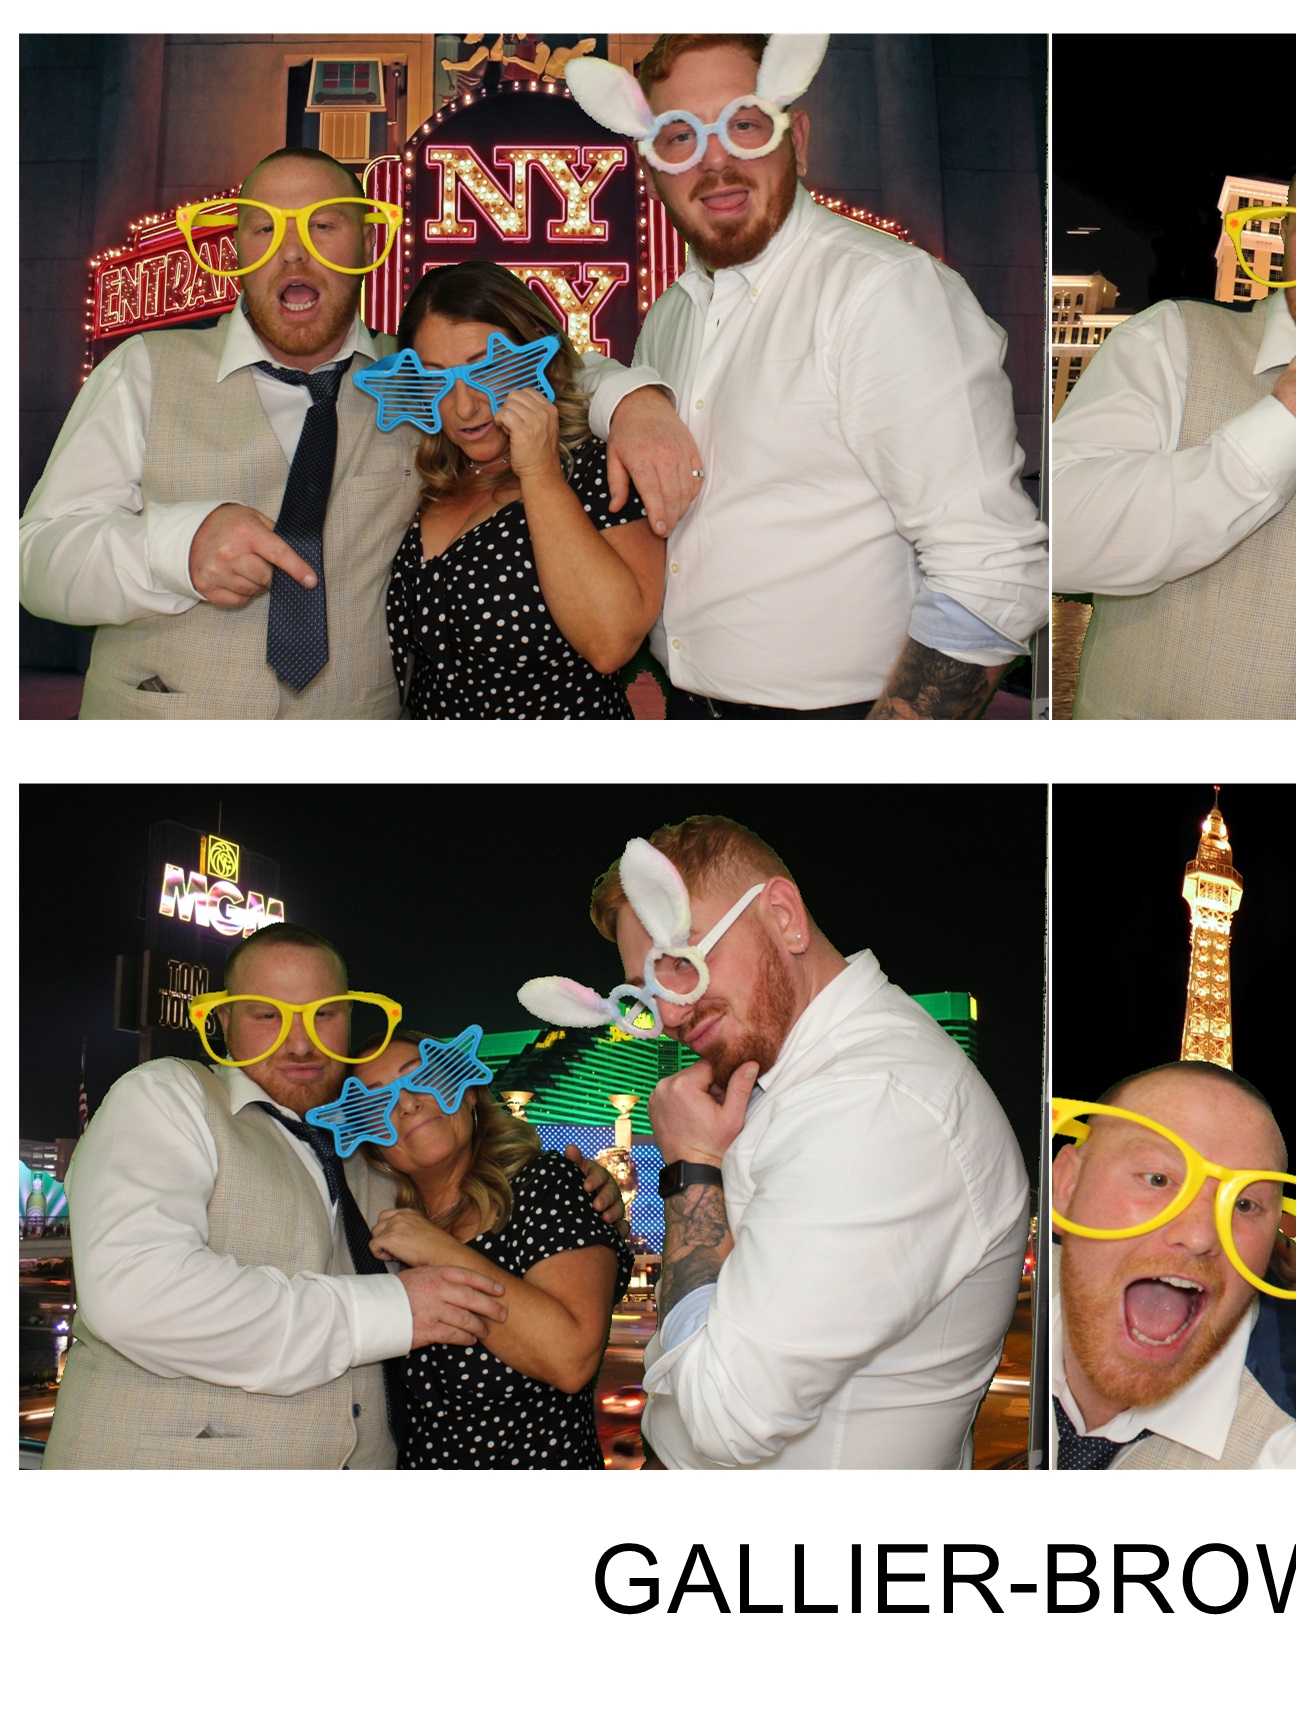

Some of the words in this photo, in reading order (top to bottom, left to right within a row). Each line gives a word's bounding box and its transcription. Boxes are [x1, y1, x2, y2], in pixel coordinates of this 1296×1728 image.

[425, 145, 627, 242] NY
[158, 862, 285, 939] MGM
[168, 959, 209, 996] TOM
[159, 994, 216, 1036] JONS
